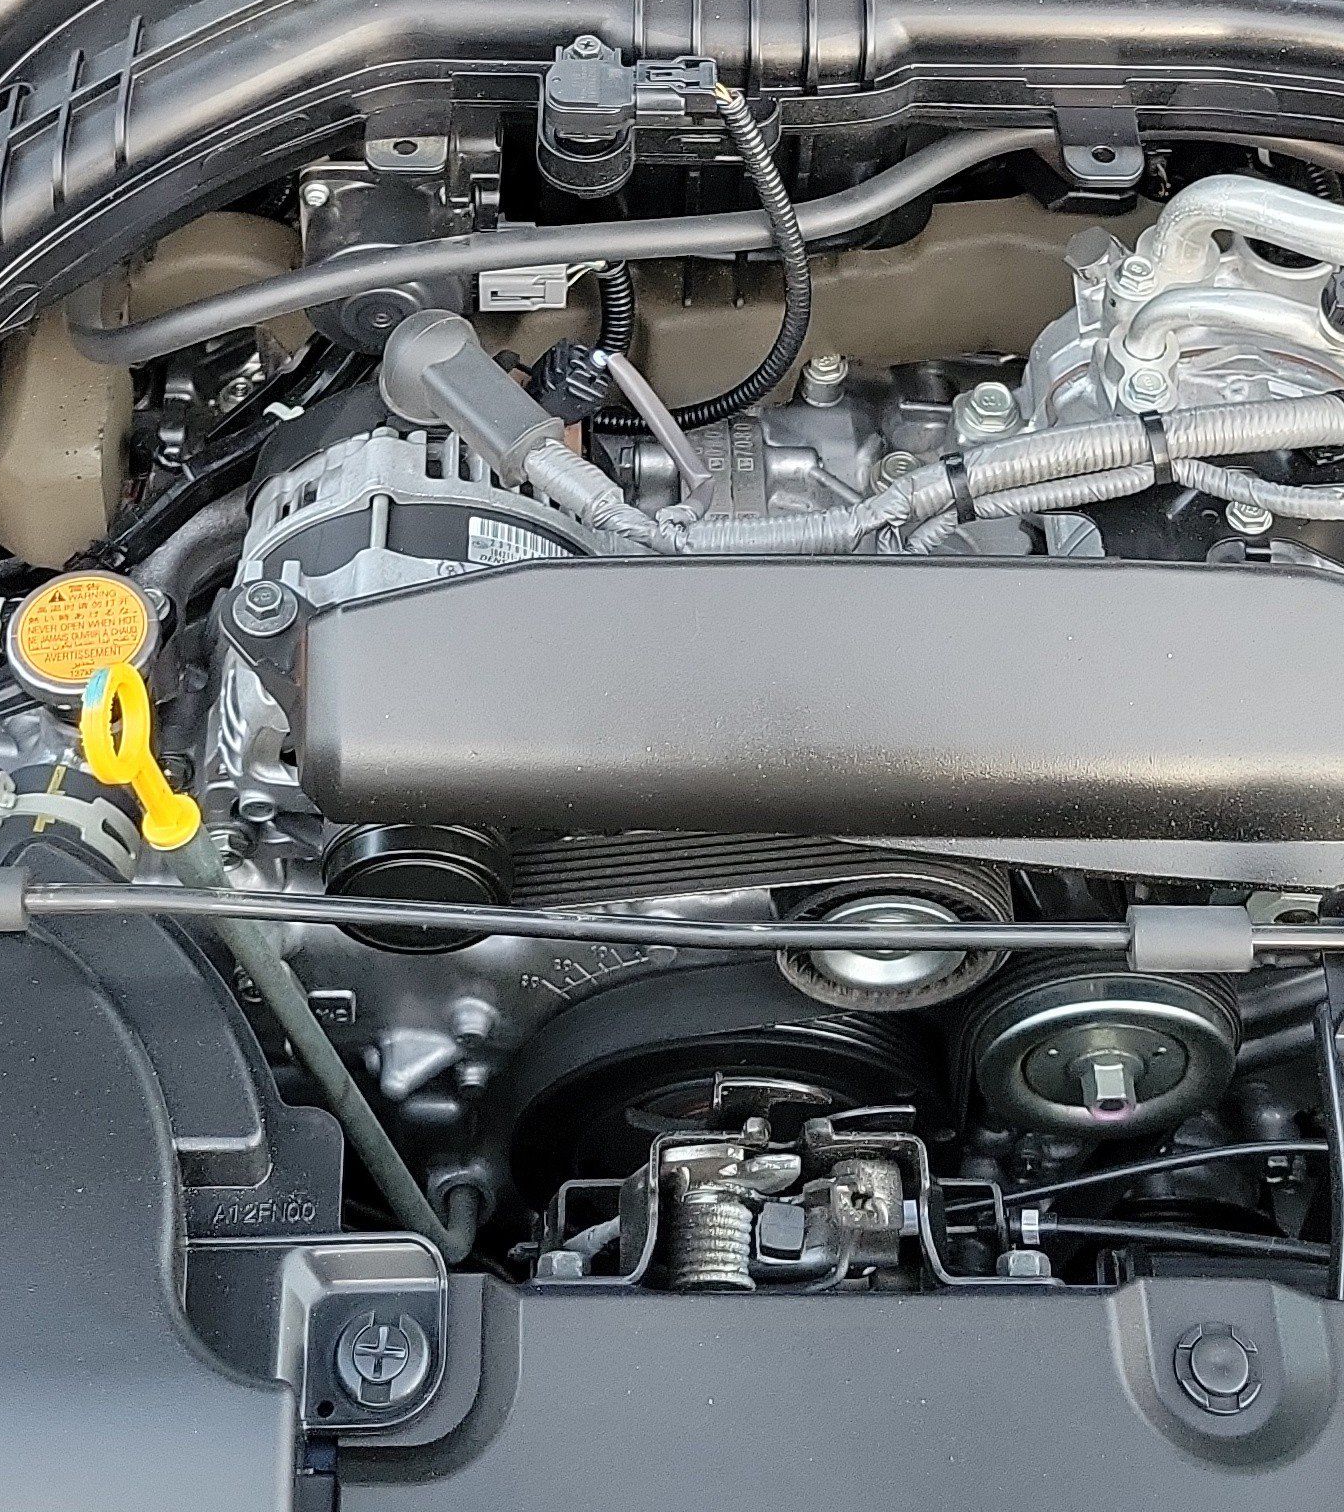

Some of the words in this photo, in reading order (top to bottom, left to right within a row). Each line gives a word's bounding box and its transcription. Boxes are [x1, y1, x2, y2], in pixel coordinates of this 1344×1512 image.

[68, 589, 117, 601] WARNING
[27, 624, 57, 635] NEVER
[60, 621, 85, 632] OPEN
[88, 618, 116, 629] WHEN
[40, 633, 69, 644] JAMAIS
[44, 646, 123, 663] AVERTISSEMENT
